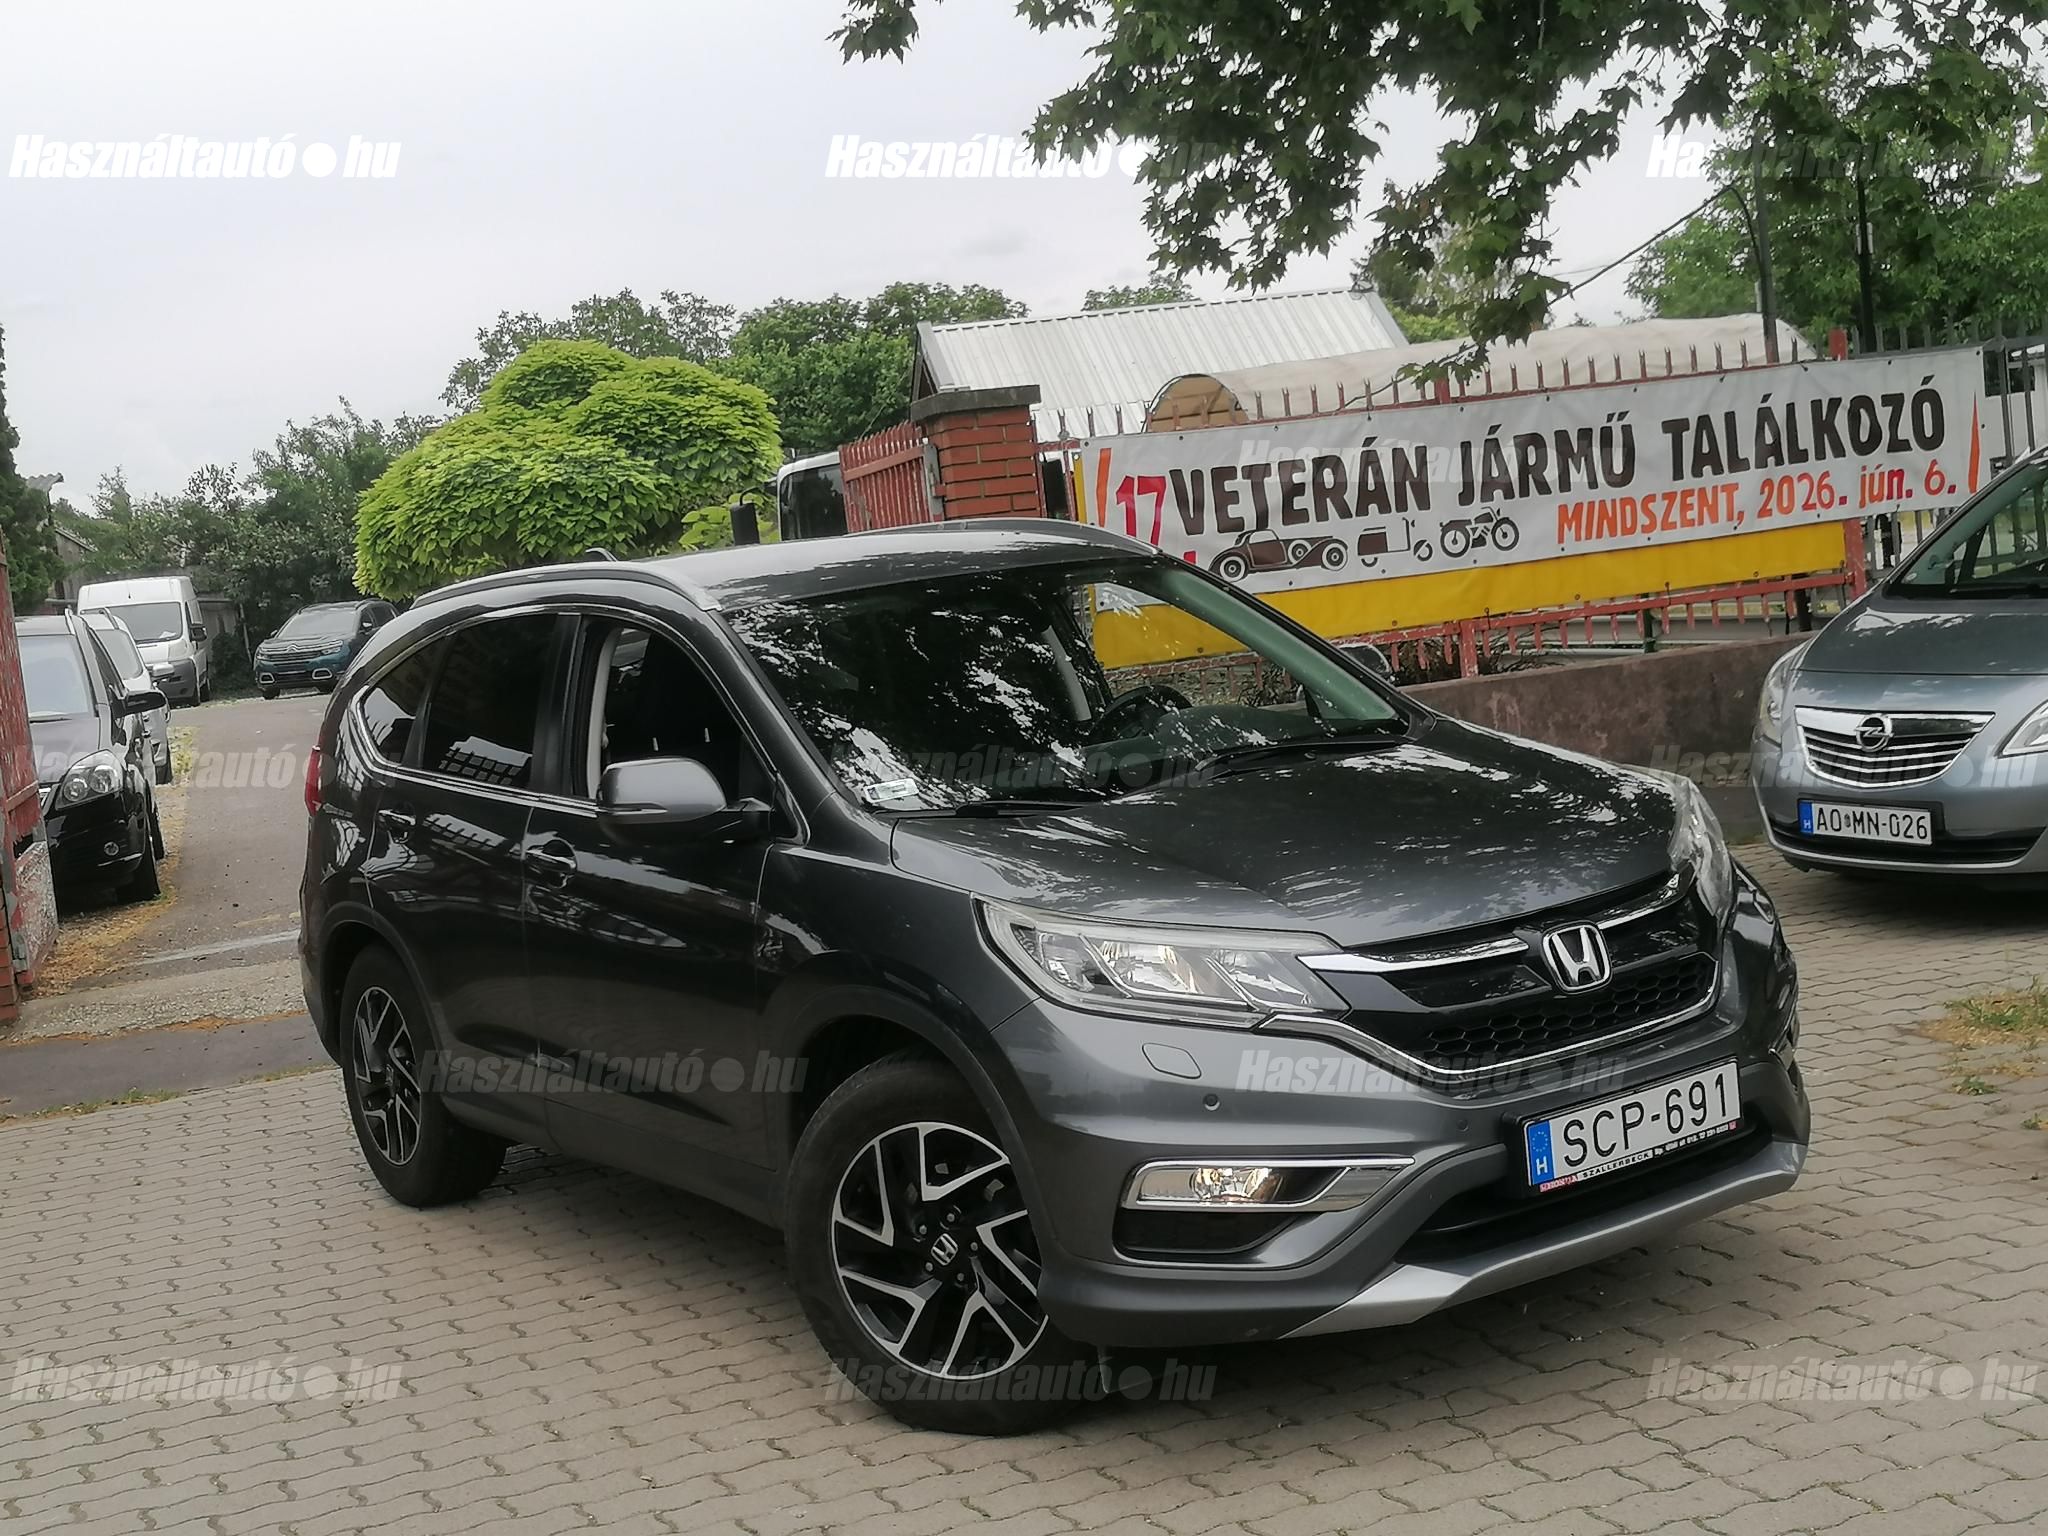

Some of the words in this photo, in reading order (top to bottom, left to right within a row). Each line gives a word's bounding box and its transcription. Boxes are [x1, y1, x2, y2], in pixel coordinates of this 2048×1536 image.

[1168, 436, 1431, 536] VETERÁN
[1458, 410, 1636, 506] JÁRMŰ
[1661, 374, 1945, 481] TALÁLKOZÓ
[1557, 482, 1745, 544] MINDSZENT,
[1756, 470, 1847, 519] 2026.
[1859, 463, 1913, 509] jún.
[1924, 459, 1957, 496] 6.
[1535, 1155, 1549, 1177] H
[1563, 1072, 1727, 1168] SCP-691
